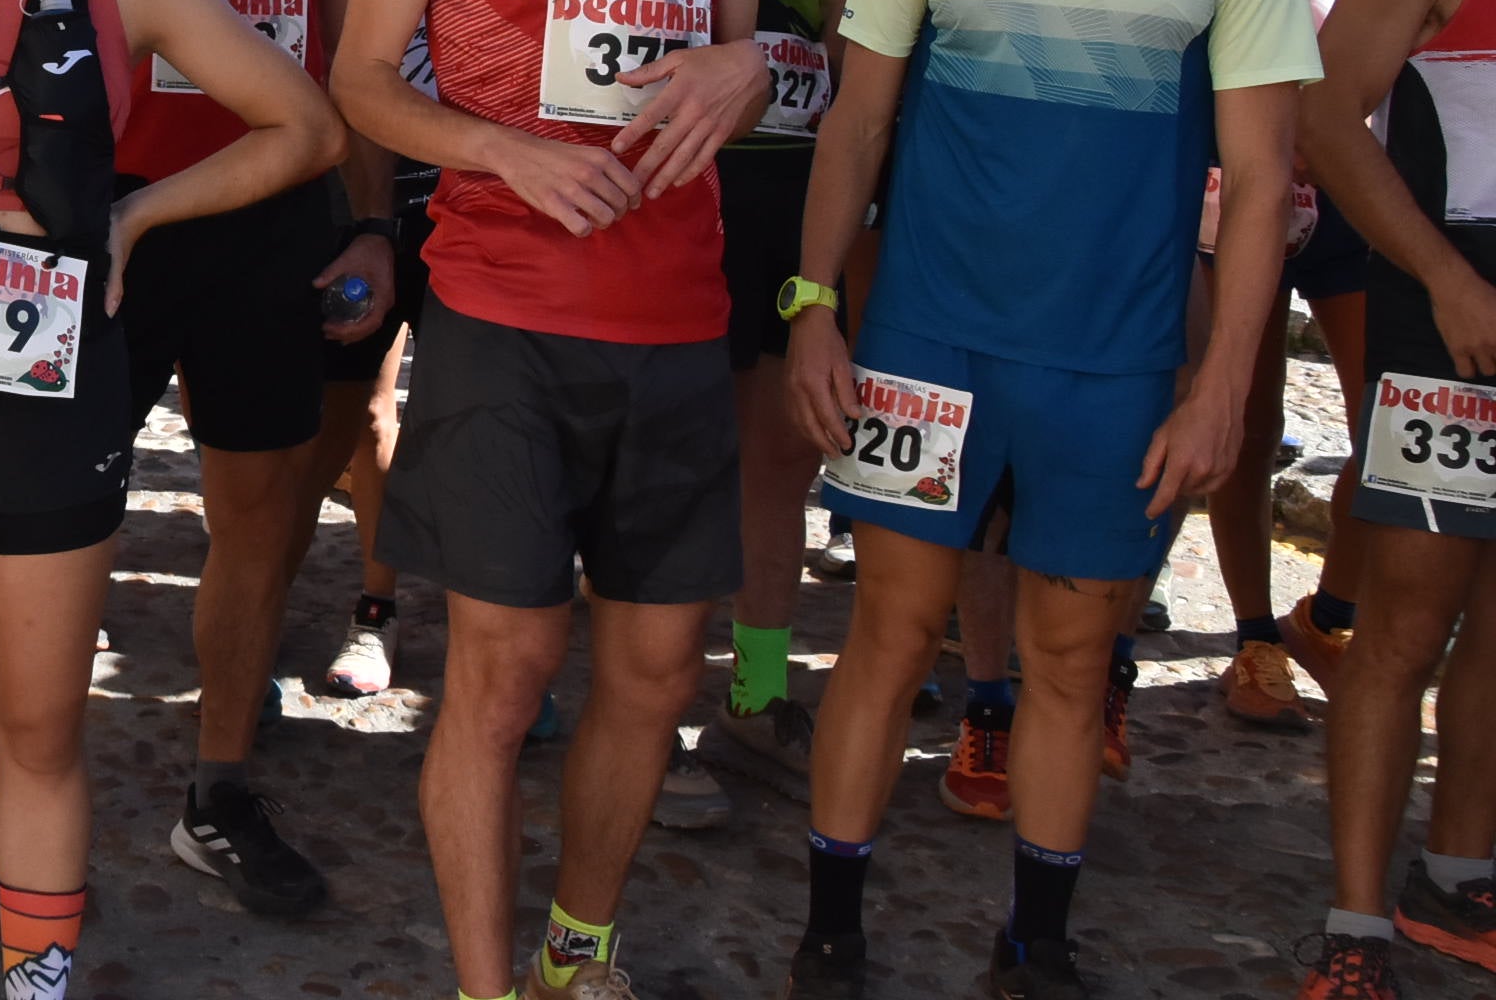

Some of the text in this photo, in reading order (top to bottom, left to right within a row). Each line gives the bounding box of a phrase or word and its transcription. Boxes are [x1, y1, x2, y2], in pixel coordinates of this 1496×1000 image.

[758, 39, 826, 72] edunia
[853, 376, 966, 430] dunia
[1379, 378, 1496, 423] bedun
[1401, 418, 1496, 475] 333
